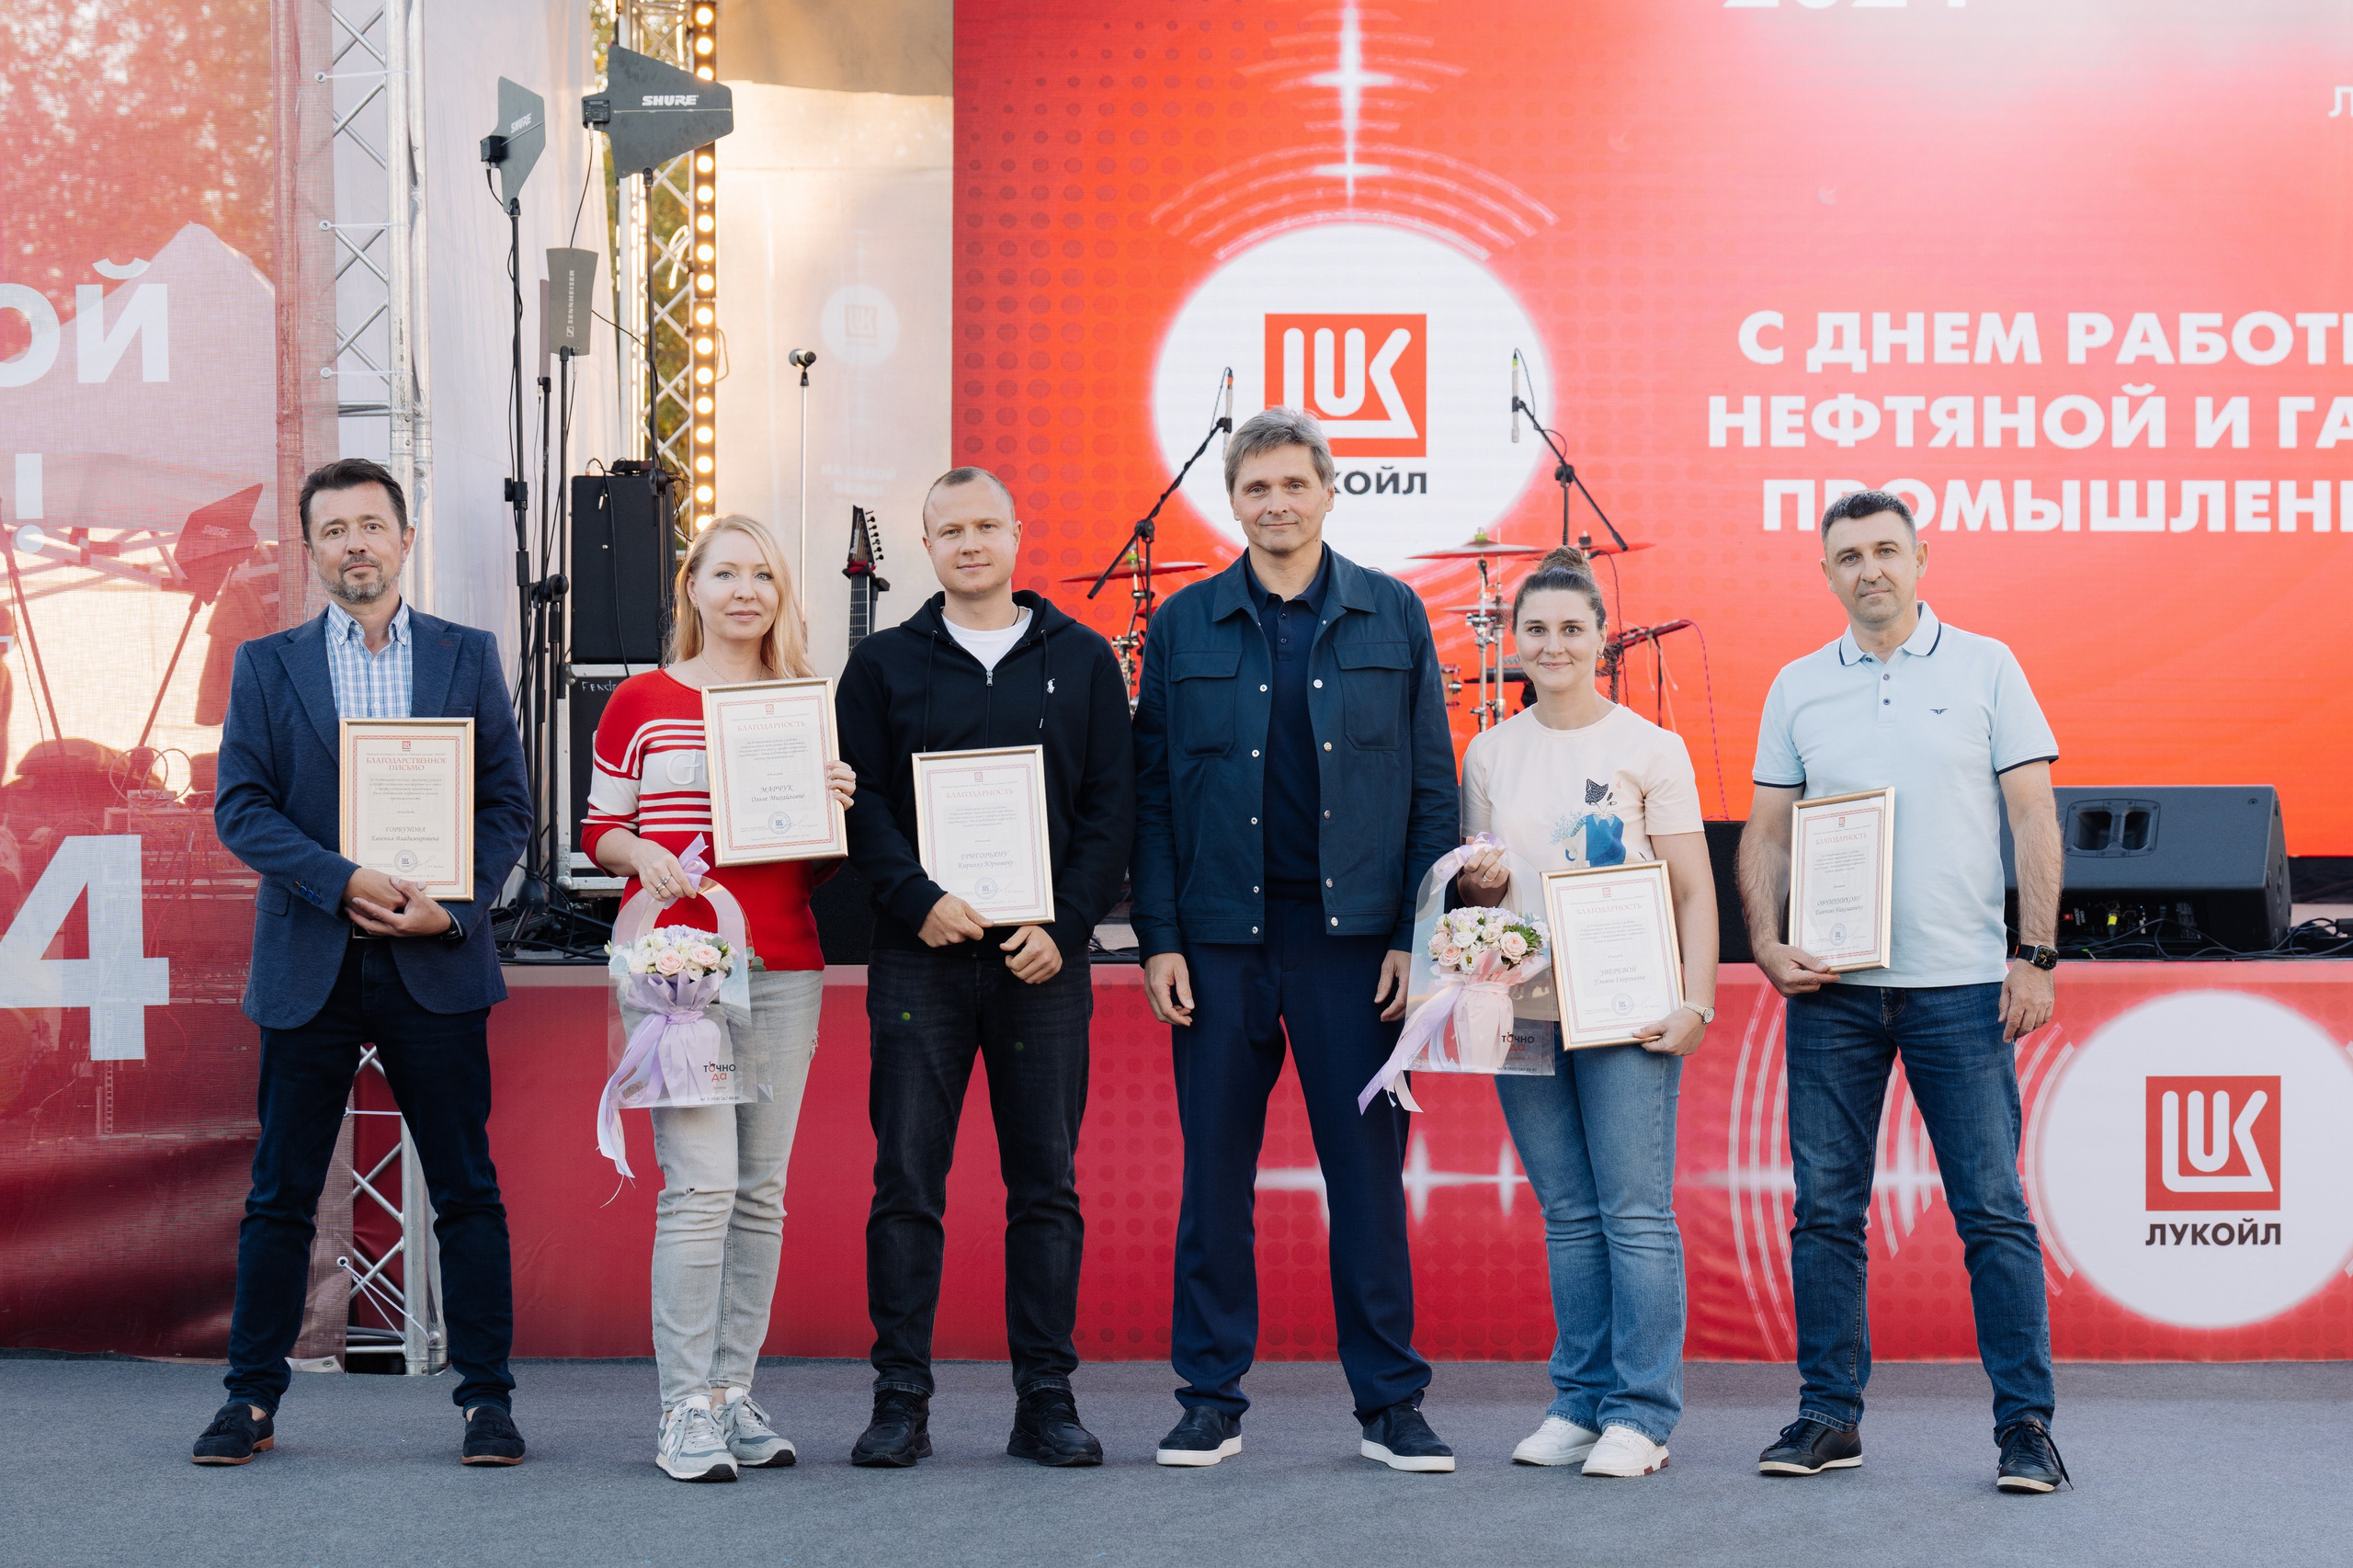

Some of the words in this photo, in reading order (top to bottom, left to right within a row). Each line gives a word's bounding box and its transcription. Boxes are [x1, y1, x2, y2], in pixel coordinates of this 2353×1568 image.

[642, 95, 697, 107] SHURE
[510, 112, 531, 133] SHURE
[1738, 310, 1784, 365] С
[1806, 312, 2042, 373] ДНЕМ
[2068, 311, 2353, 366] РАБОТ
[1709, 383, 2166, 449] НЕФТЯНОЙ
[2195, 396, 2250, 449] И
[1334, 465, 1427, 495] ОЙЛ
[1763, 478, 2353, 533] ПОМЫШЛЕН
[737, 721, 806, 732] БЛАГОДАРНОСТЬ
[946, 789, 1014, 799] БЛАГОДАРНОСТЬ
[1815, 833, 1868, 845] БЛАГОДАРНОСТЬ
[1576, 903, 1643, 915] БЛАГОДАРНОСТЬ
[0, 835, 169, 1061] 4
[2145, 1218, 2281, 1246] ЛУКОЙЛ
